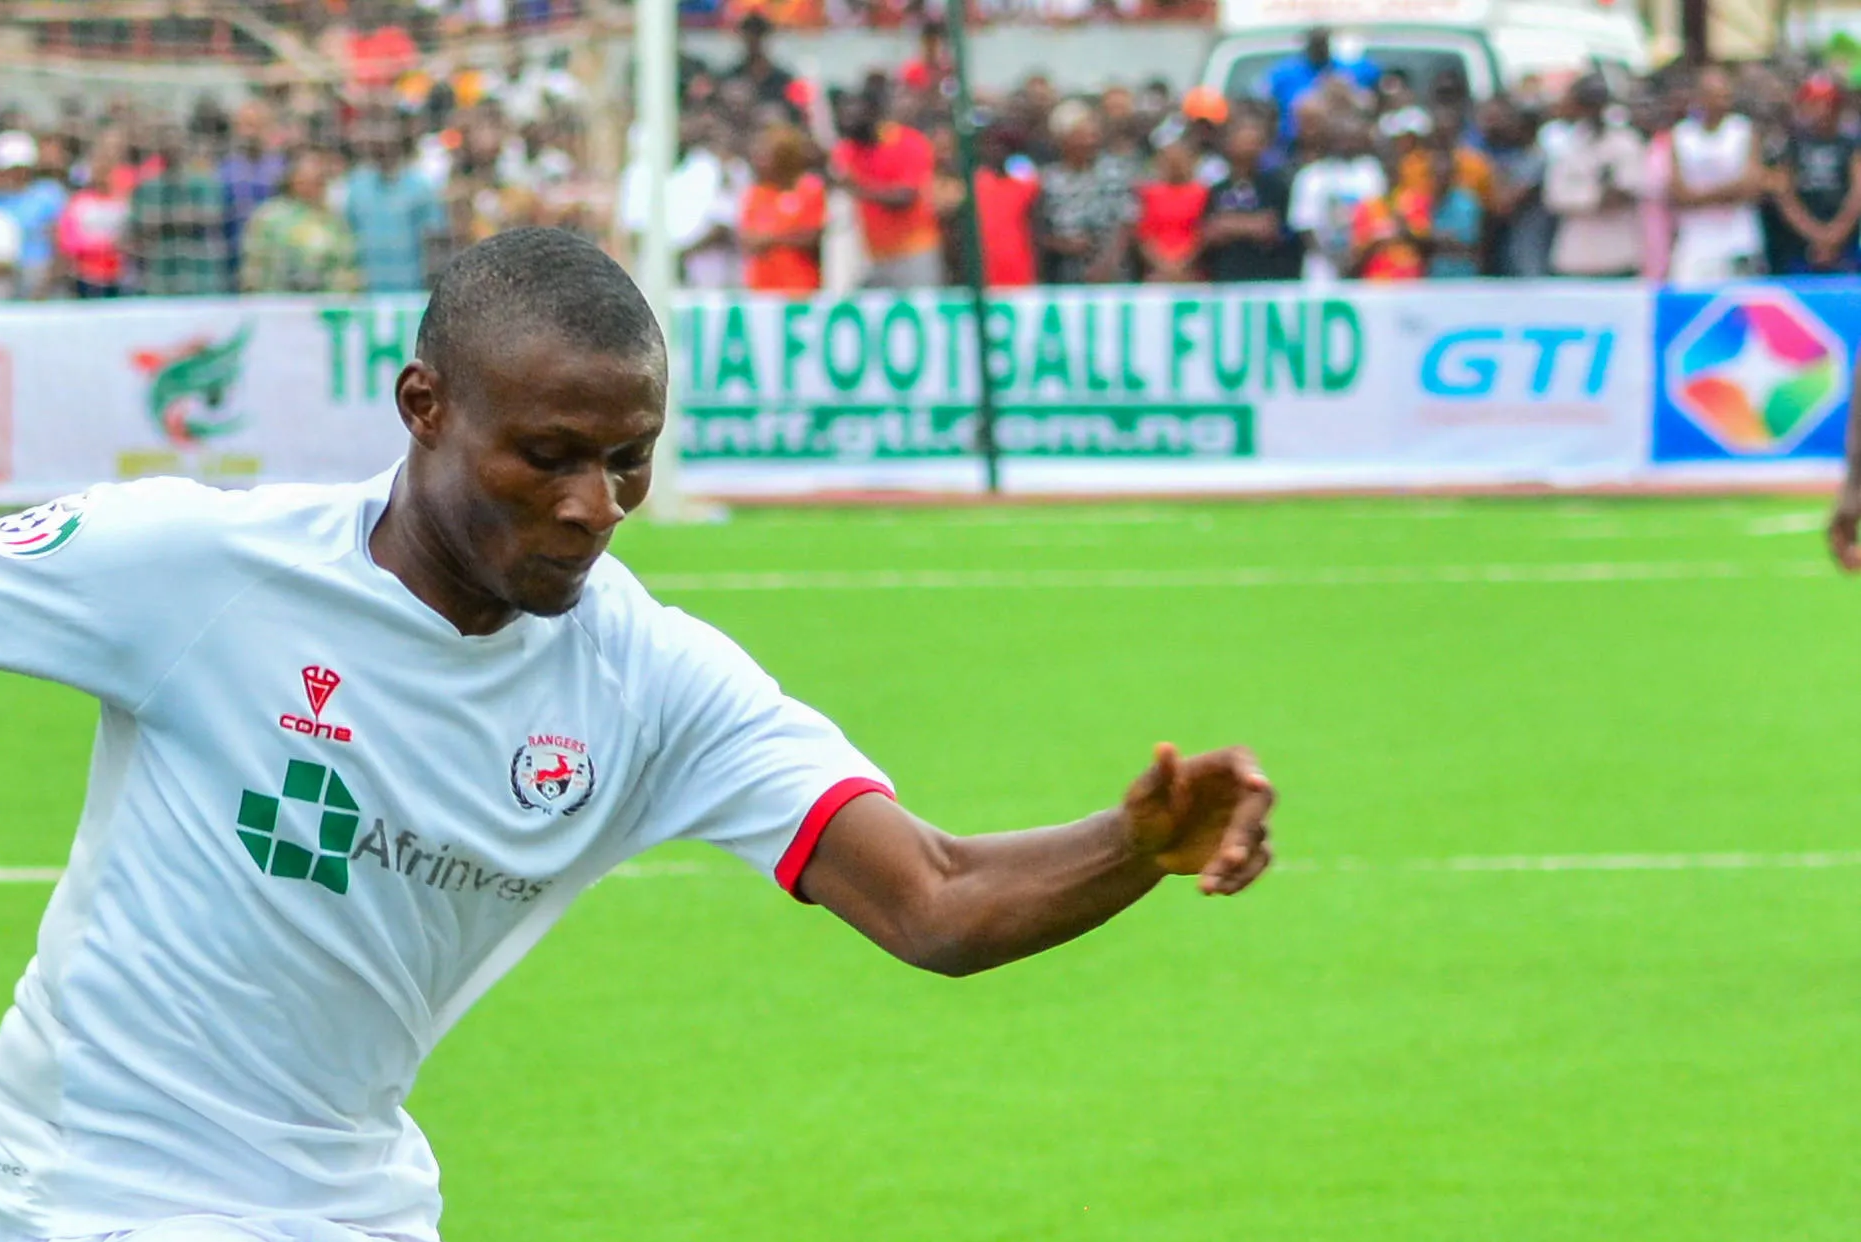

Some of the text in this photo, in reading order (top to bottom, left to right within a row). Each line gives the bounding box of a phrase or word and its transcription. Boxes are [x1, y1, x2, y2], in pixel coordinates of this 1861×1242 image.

[319, 308, 426, 400] TH
[783, 300, 1146, 392] FOOTBALL
[1173, 299, 1363, 392] FUND
[1420, 328, 1613, 397] GTI
[279, 713, 353, 742] cone
[527, 735, 587, 753] RANGERS
